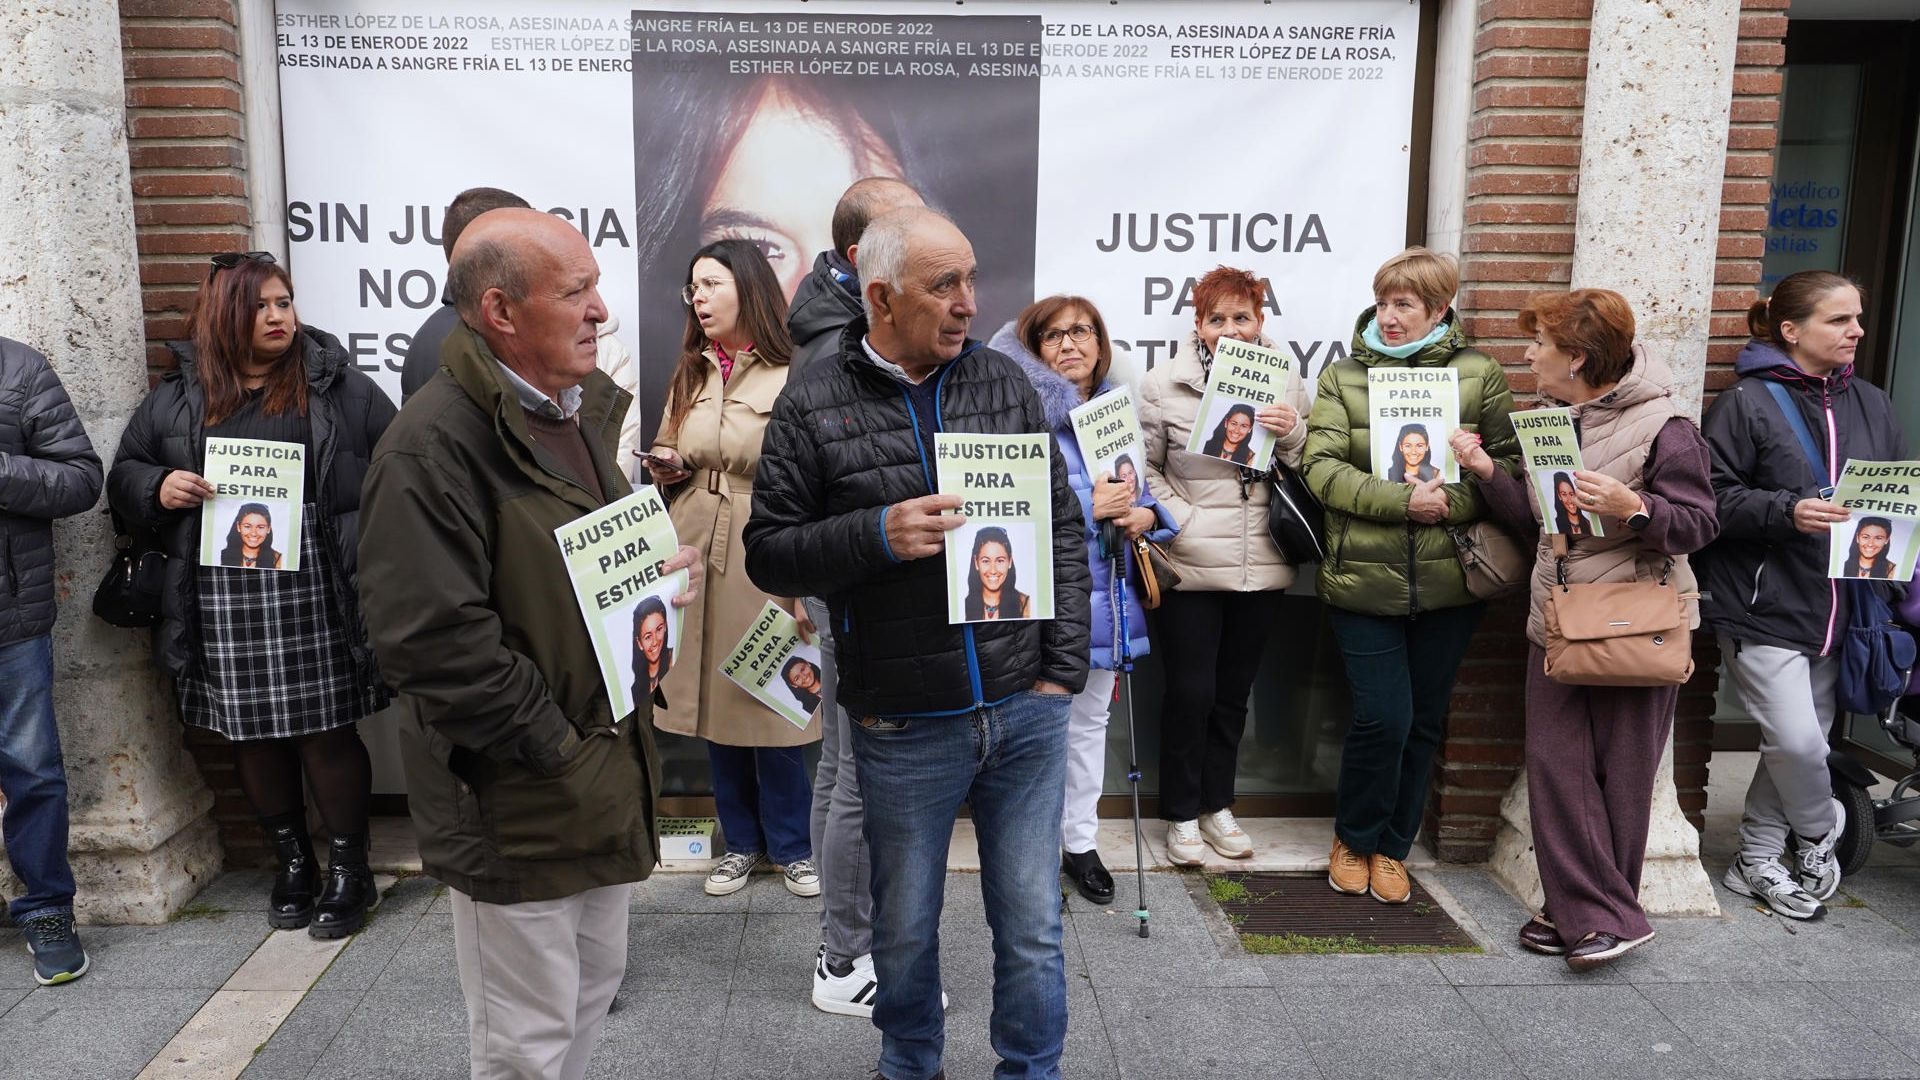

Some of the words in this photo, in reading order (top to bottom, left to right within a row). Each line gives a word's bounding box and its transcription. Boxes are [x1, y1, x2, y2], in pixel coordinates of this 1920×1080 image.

[276, 14, 340, 28] ESTHER
[345, 13, 397, 29] LÓPEZ
[402, 16, 423, 29] DE
[429, 16, 450, 30] LA
[454, 16, 504, 32] ROSA,
[508, 17, 604, 30] ASESINADA
[608, 18, 619, 31] A
[624, 19, 692, 32] SANGRE
[697, 18, 735, 33] FRÍA
[739, 22, 759, 34] EL
[764, 22, 782, 34] 13
[786, 22, 808, 34] DE
[814, 22, 892, 34] ENERODE
[897, 23, 934, 36] 2022
[1070, 24, 1092, 37] DE
[1097, 24, 1118, 37] LA
[1122, 24, 1172, 40] ROSA,
[1176, 25, 1270, 39] ASESINADA
[1273, 26, 1284, 40] A
[1288, 26, 1355, 40] SANGRE
[1358, 24, 1396, 40] FRÍA
[278, 34, 296, 47] EL
[300, 35, 318, 48] 13
[324, 36, 346, 48] DE
[352, 36, 428, 50] ENERODE
[433, 37, 468, 50] 2022
[491, 38, 556, 51] ESTHER
[562, 34, 614, 52] LÓPEZ
[620, 38, 641, 52] DE
[646, 39, 668, 52] LA
[672, 40, 722, 54] ROSA,
[726, 40, 822, 54] ASESINADA
[825, 42, 836, 54] A
[840, 41, 910, 54] SANGRE
[914, 39, 952, 56] FRÍA
[956, 42, 976, 56] EL
[980, 43, 998, 56] 13
[1003, 44, 1024, 56] DE
[1030, 44, 1108, 58] ENERODE
[1114, 44, 1148, 58] 2022
[1170, 46, 1234, 59] ESTHER
[1240, 43, 1292, 60] LÓPEZ
[1296, 46, 1317, 60] DE
[1322, 47, 1342, 60] LA
[1346, 48, 1396, 62] ROSA,
[279, 54, 374, 70] ASESINADA
[376, 57, 388, 70] A
[391, 57, 458, 70] SANGRE
[463, 54, 500, 70] FRÍA
[504, 58, 524, 70] EL
[530, 58, 546, 71] 13
[552, 59, 573, 72] DE
[730, 60, 794, 74] ESTHER
[800, 58, 852, 74] LÓPEZ
[858, 62, 879, 74] DE
[884, 62, 906, 75] LA
[910, 62, 960, 78] ROSA,
[968, 63, 1064, 76] ASESINADA
[1066, 64, 1078, 77] A
[1082, 64, 1149, 78] SANGRE
[1154, 62, 1190, 78] FRÍA
[1196, 66, 1214, 78] EL
[1220, 66, 1236, 79] 13
[1242, 66, 1263, 79] DE
[1267, 67, 1343, 80] ENERODE
[1348, 68, 1384, 80] 2022
[288, 202, 369, 243] SIN
[389, 205, 630, 248] JUIA
[1096, 212, 1332, 254] JUSTICIA
[359, 268, 437, 310] NO
[1144, 276, 1282, 316] PAA
[1218, 344, 1290, 371] #JUSTICIA
[1232, 366, 1270, 384] PARA
[1369, 372, 1452, 383] #JUSTICIA
[1216, 382, 1275, 404] ESTHER
[1389, 390, 1432, 400] PARA
[1078, 396, 1130, 428] #JUSTICIA
[1380, 407, 1442, 418] ESTHER
[1096, 419, 1124, 440] PARA
[1514, 416, 1570, 430] #JUSTICIA
[938, 443, 1045, 460] #JUSTICIA
[1095, 432, 1134, 460] ESTHER
[1534, 436, 1562, 447] PARA
[208, 444, 302, 461] #JUSTICIA
[1533, 454, 1575, 466] ESTHER
[230, 464, 278, 478] PARA
[964, 472, 1015, 488] PARA
[216, 484, 288, 498] ESTHER
[1860, 484, 1910, 495] PARA
[1843, 500, 1918, 516] ESTHER
[563, 498, 662, 557] #JUSTICIA
[598, 536, 651, 574] PARA
[724, 608, 780, 676] #JUSTICIA
[750, 635, 782, 671] PARA
[756, 635, 799, 688] ESTHER
